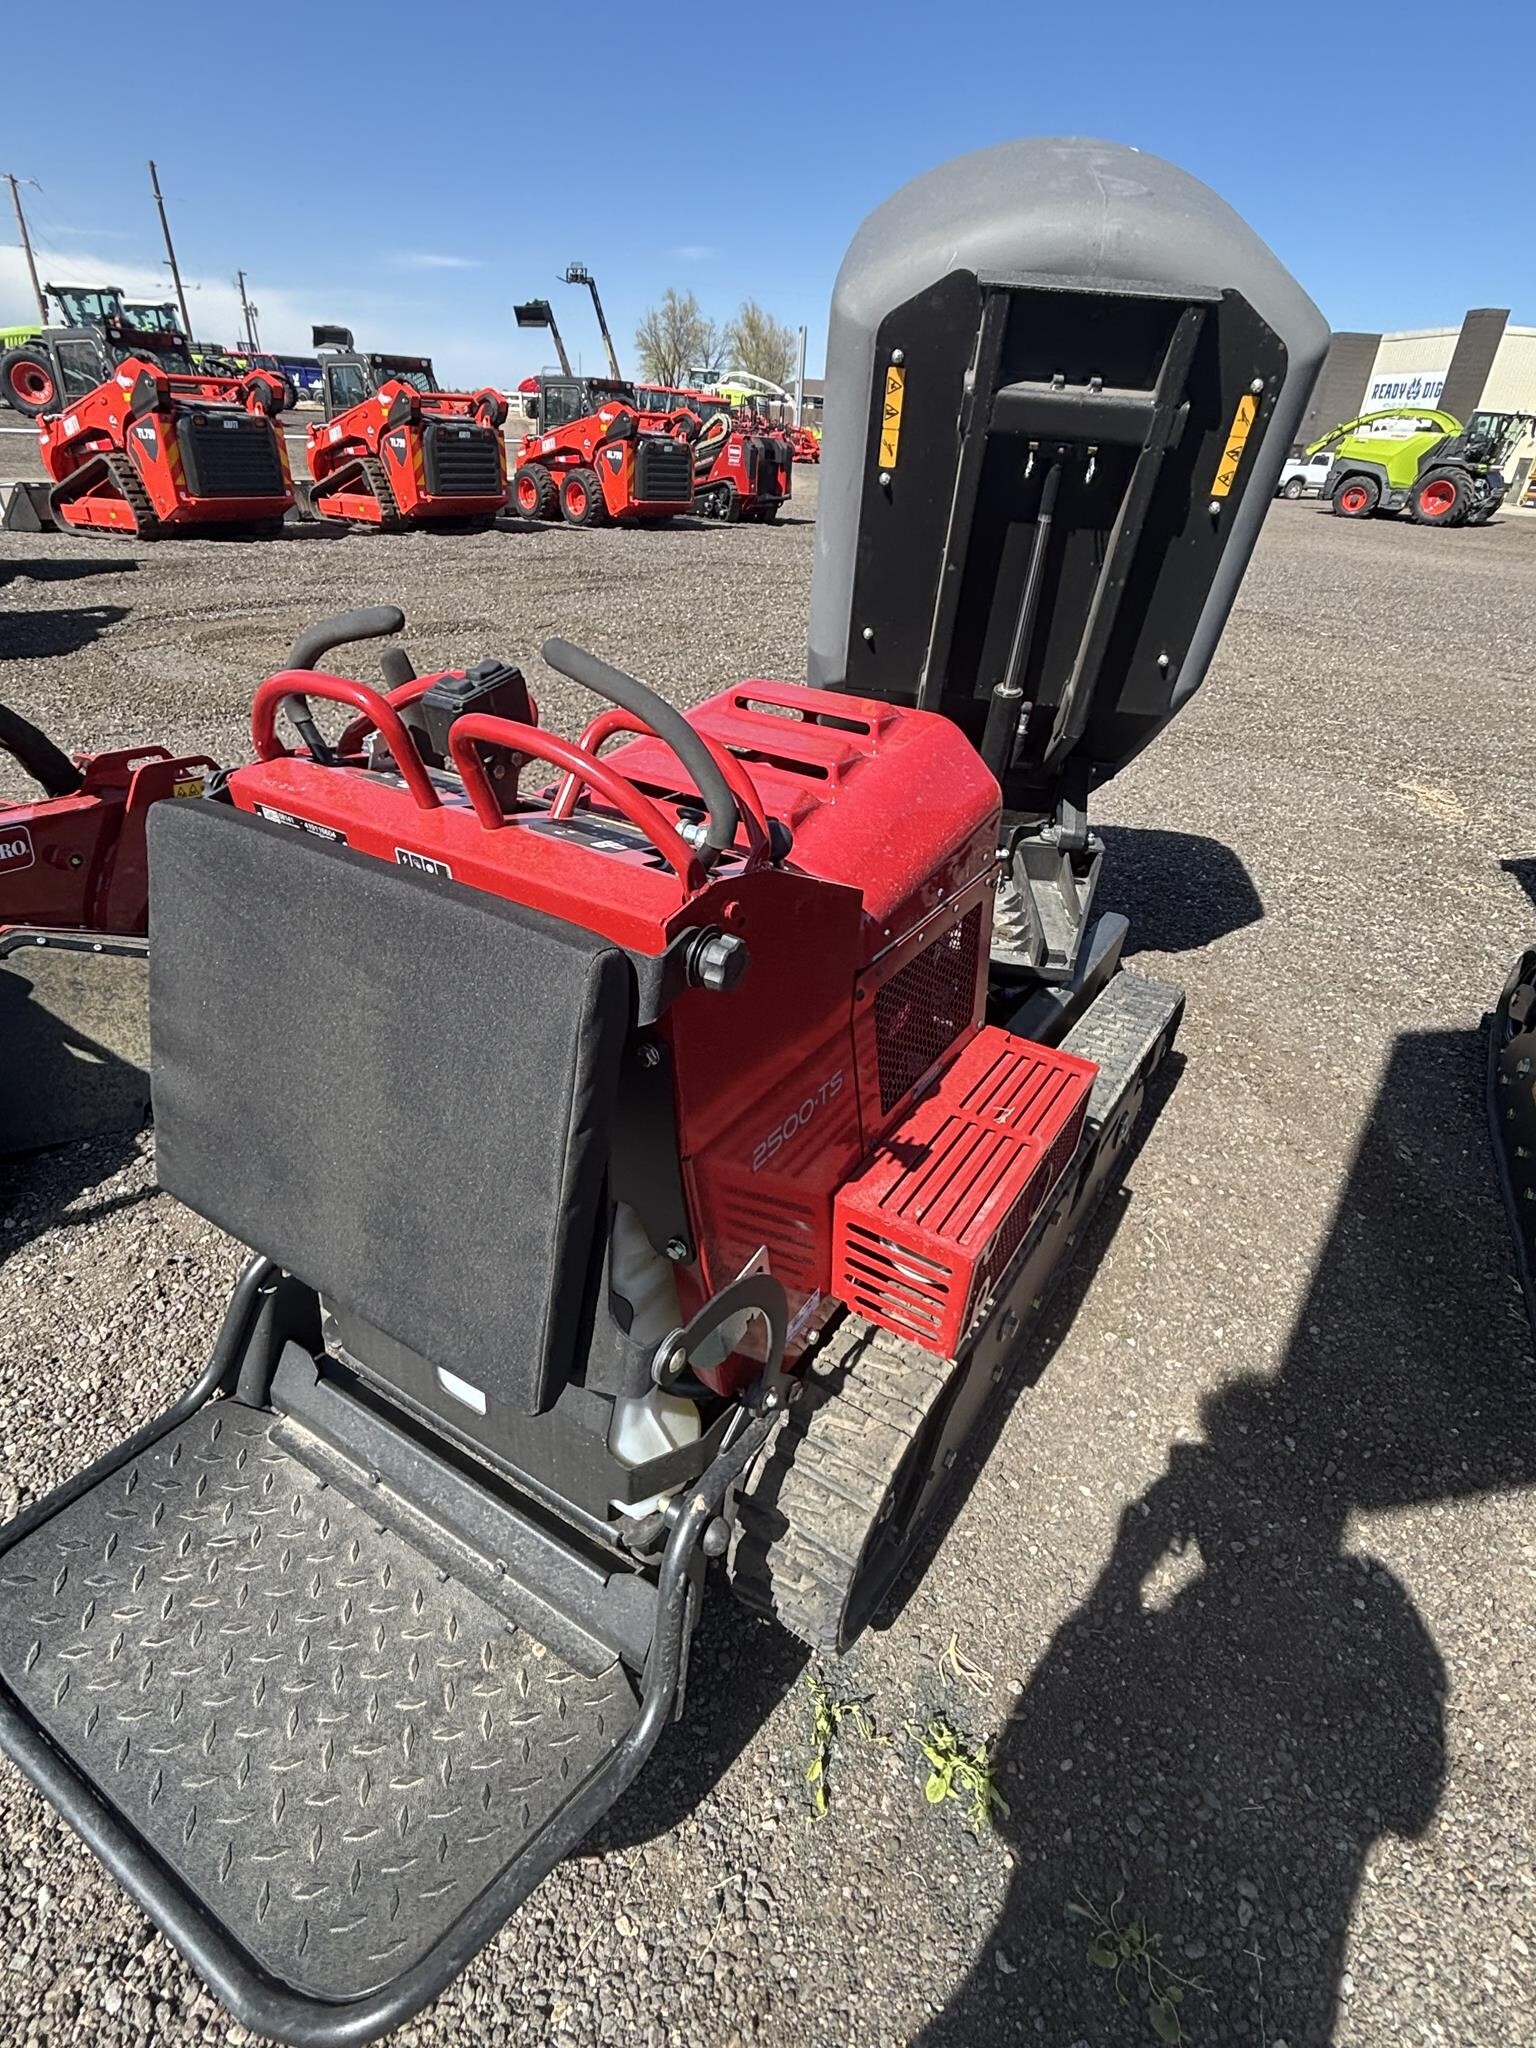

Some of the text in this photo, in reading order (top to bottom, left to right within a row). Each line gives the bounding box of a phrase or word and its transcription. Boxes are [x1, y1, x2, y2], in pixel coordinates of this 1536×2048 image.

[1371, 381, 1444, 400] READY DIG
[0, 840, 27, 860] RO
